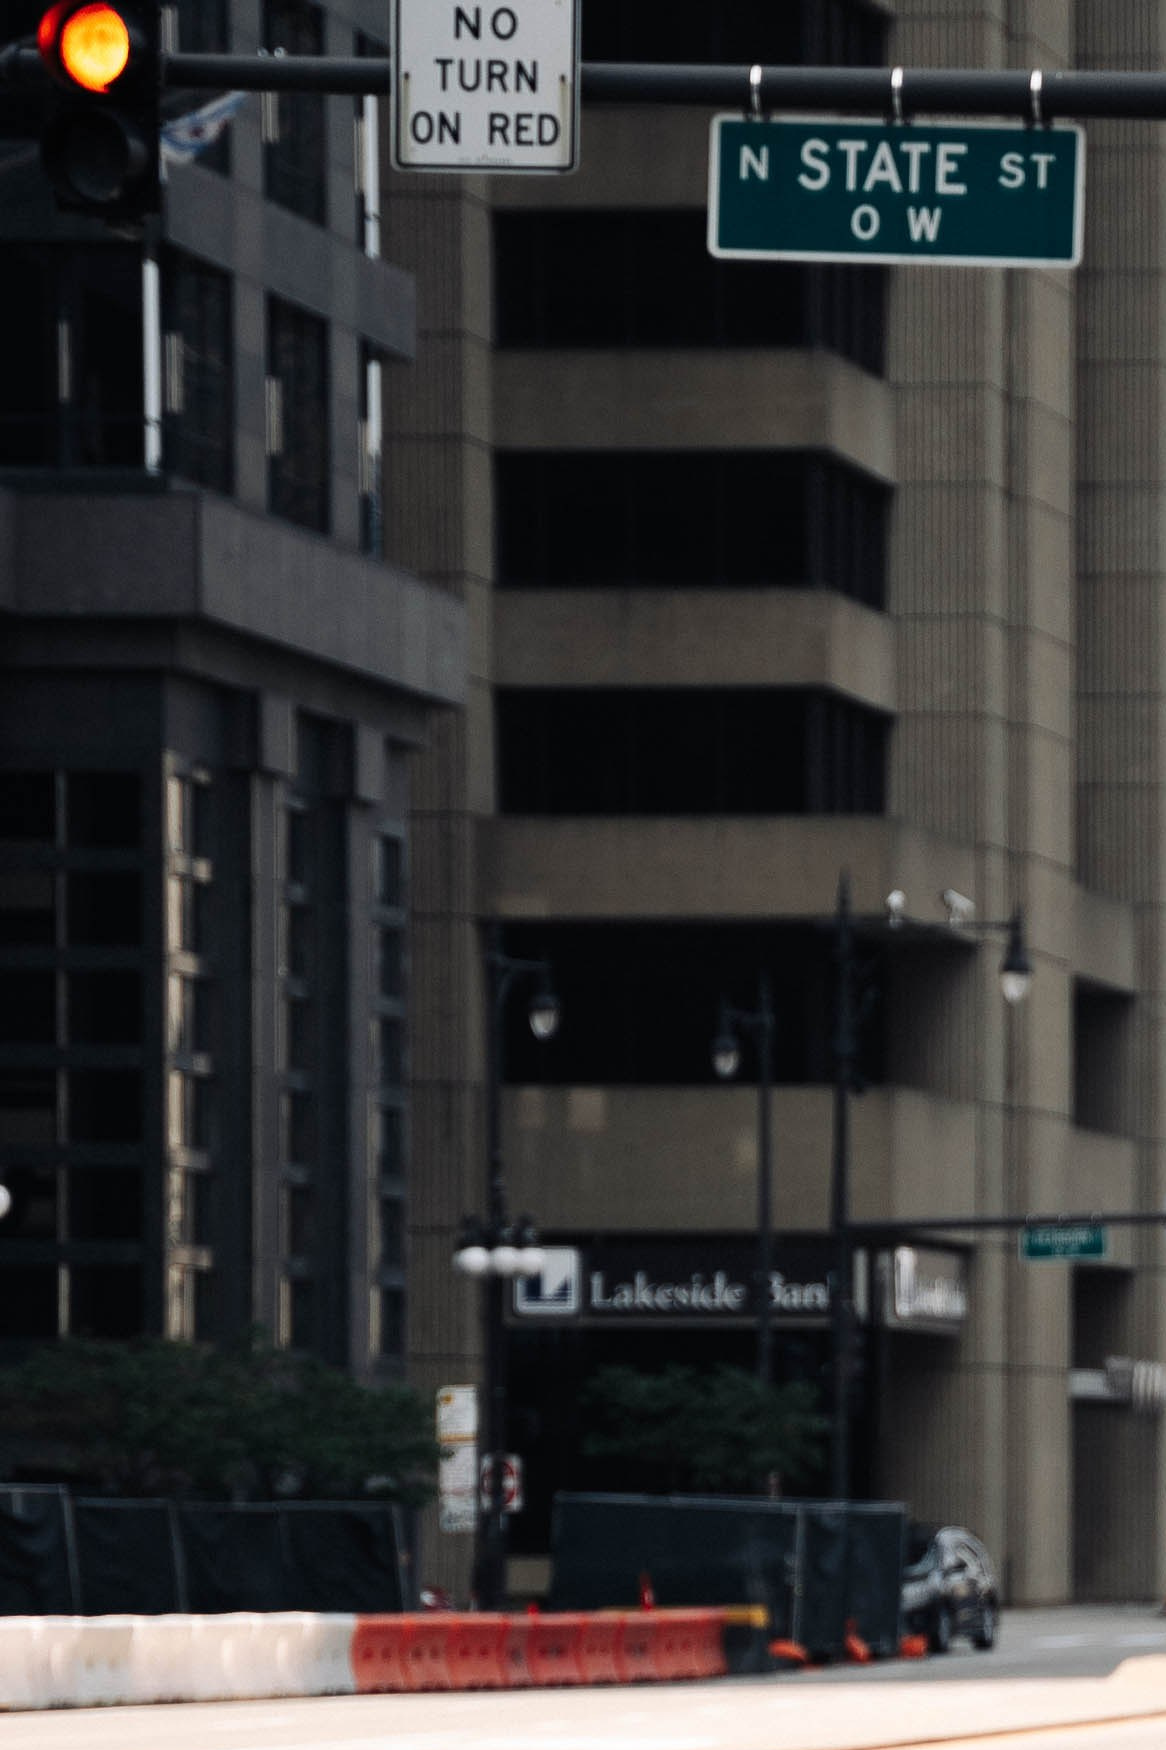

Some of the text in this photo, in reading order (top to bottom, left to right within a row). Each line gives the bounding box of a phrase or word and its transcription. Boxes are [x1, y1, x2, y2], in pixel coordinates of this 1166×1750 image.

[453, 5, 518, 41] NO
[434, 57, 538, 94] TURN
[411, 110, 560, 147] ON RED
[739, 137, 1055, 195] N STATE ST
[906, 206, 943, 242] W
[591, 1270, 746, 1312] Lakeside
